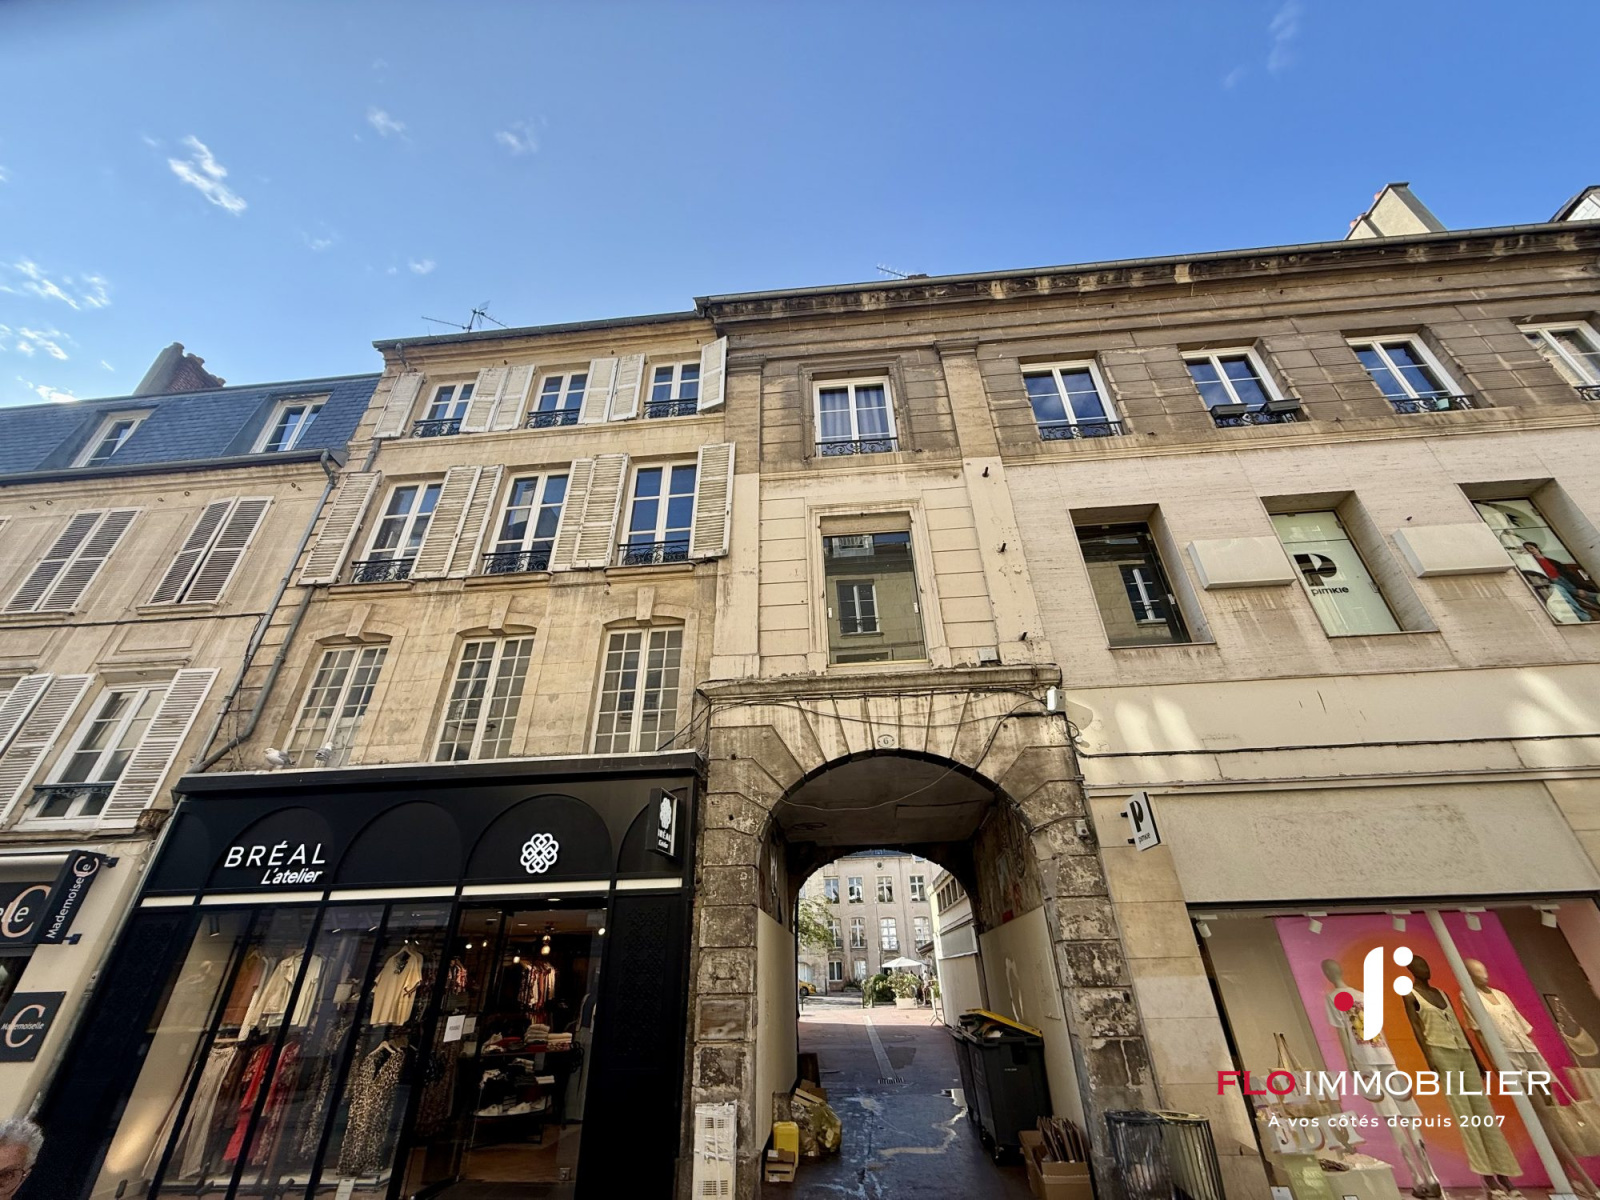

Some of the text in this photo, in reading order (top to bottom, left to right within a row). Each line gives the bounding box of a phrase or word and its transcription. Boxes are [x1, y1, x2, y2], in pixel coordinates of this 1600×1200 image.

[1311, 587, 1349, 597] pimkie
[224, 840, 326, 868] BRÉAL
[261, 867, 323, 885] L'atelier
